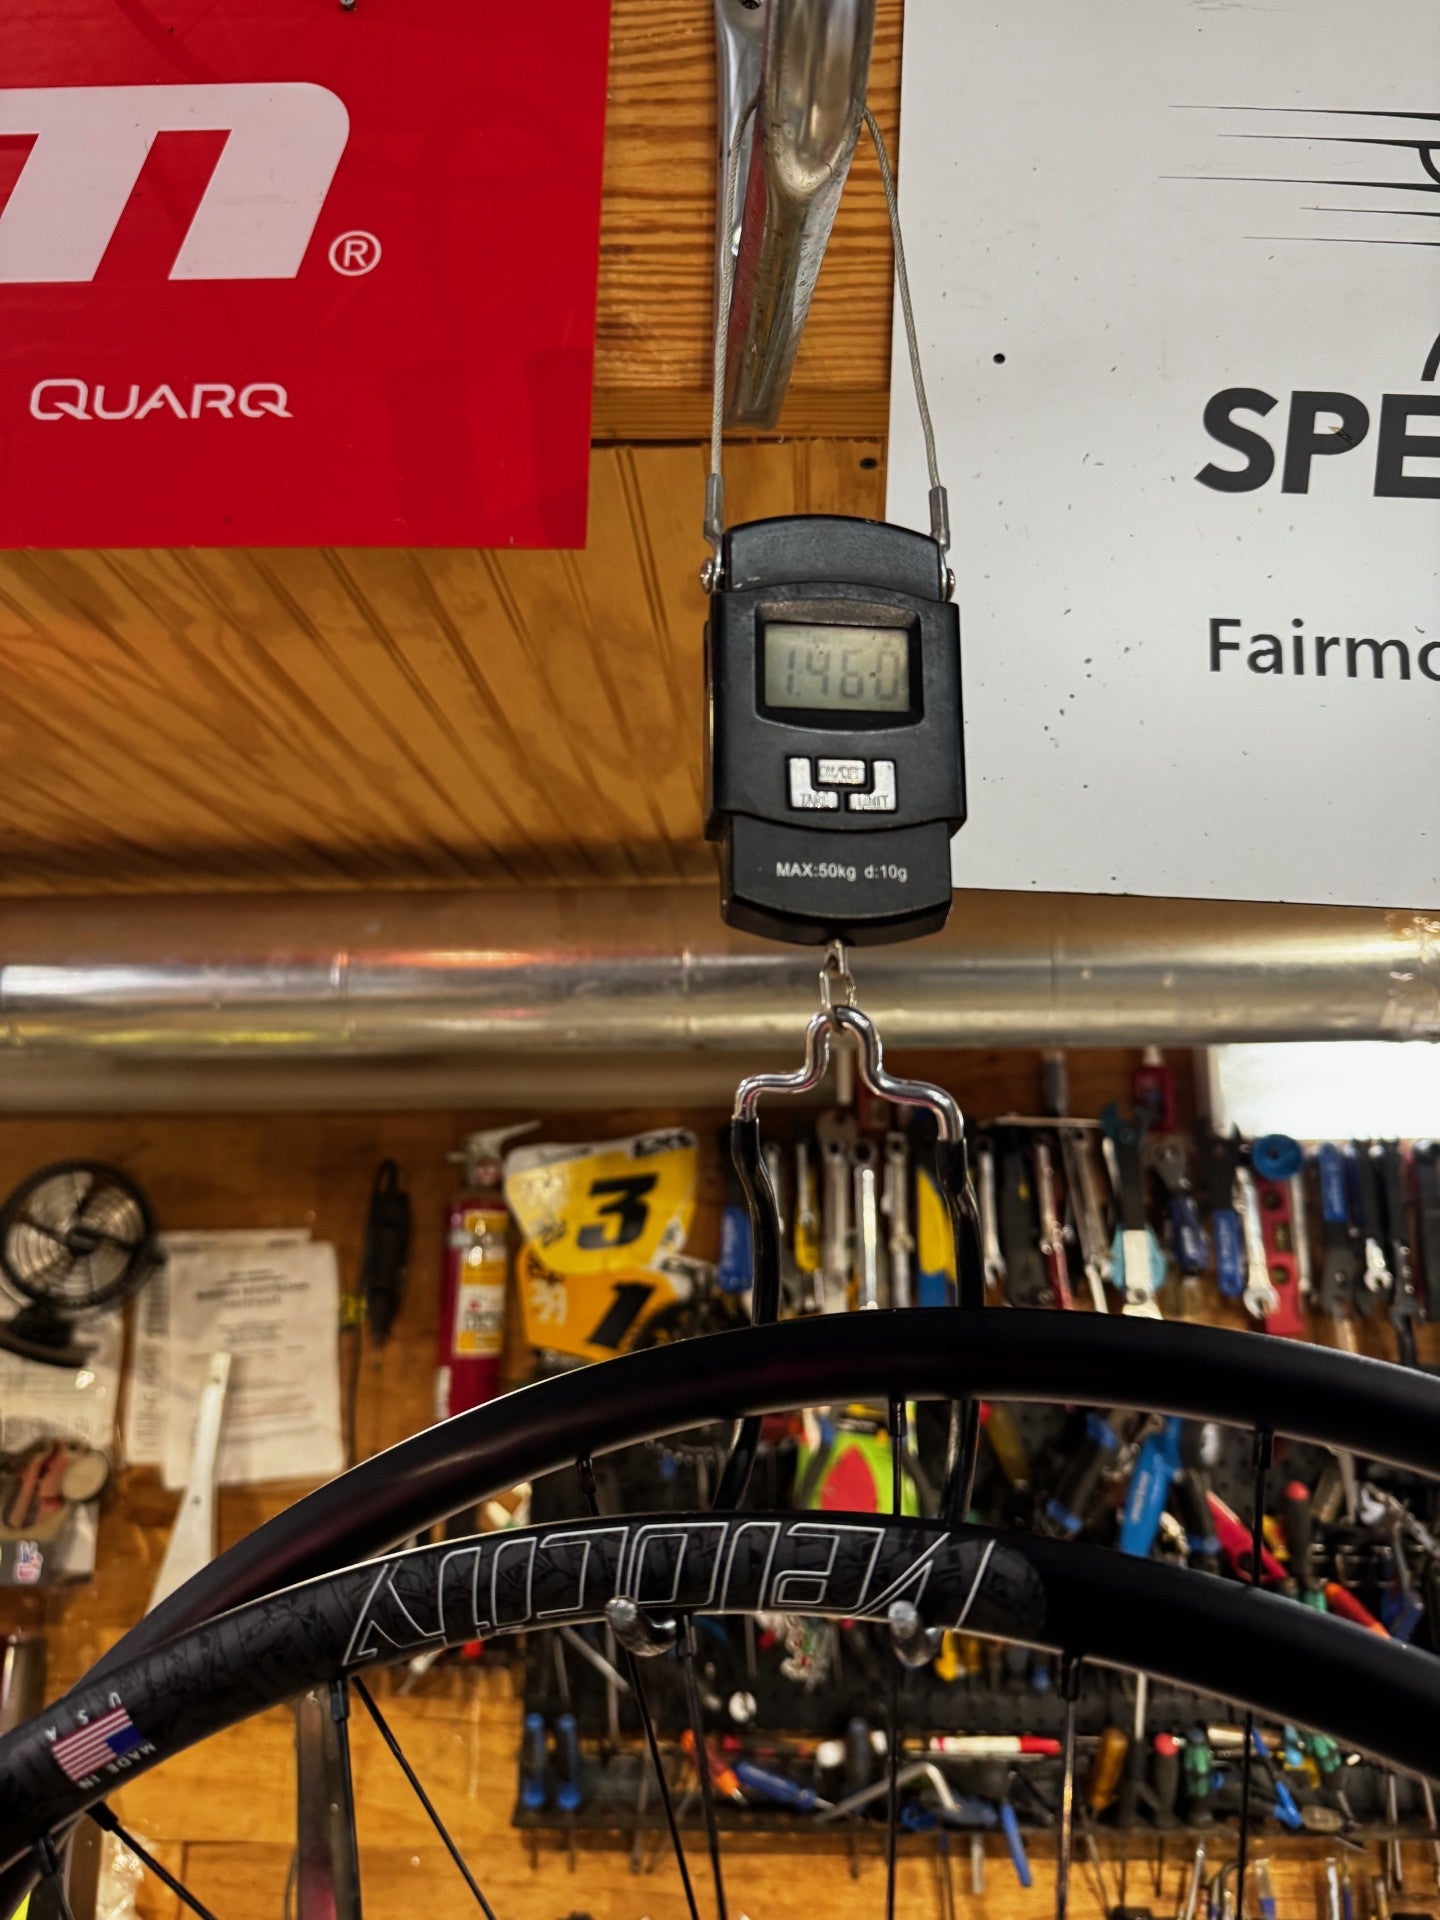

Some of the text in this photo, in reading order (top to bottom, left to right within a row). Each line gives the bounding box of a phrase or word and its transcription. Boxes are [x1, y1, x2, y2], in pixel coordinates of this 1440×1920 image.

[29, 378, 294, 421] QUARQ
[1194, 387, 1440, 500] SPE
[776, 861, 908, 883] MAX:50kg d:10g
[577, 1173, 660, 1251] 3
[77, 1742, 156, 1790] MADE IN
